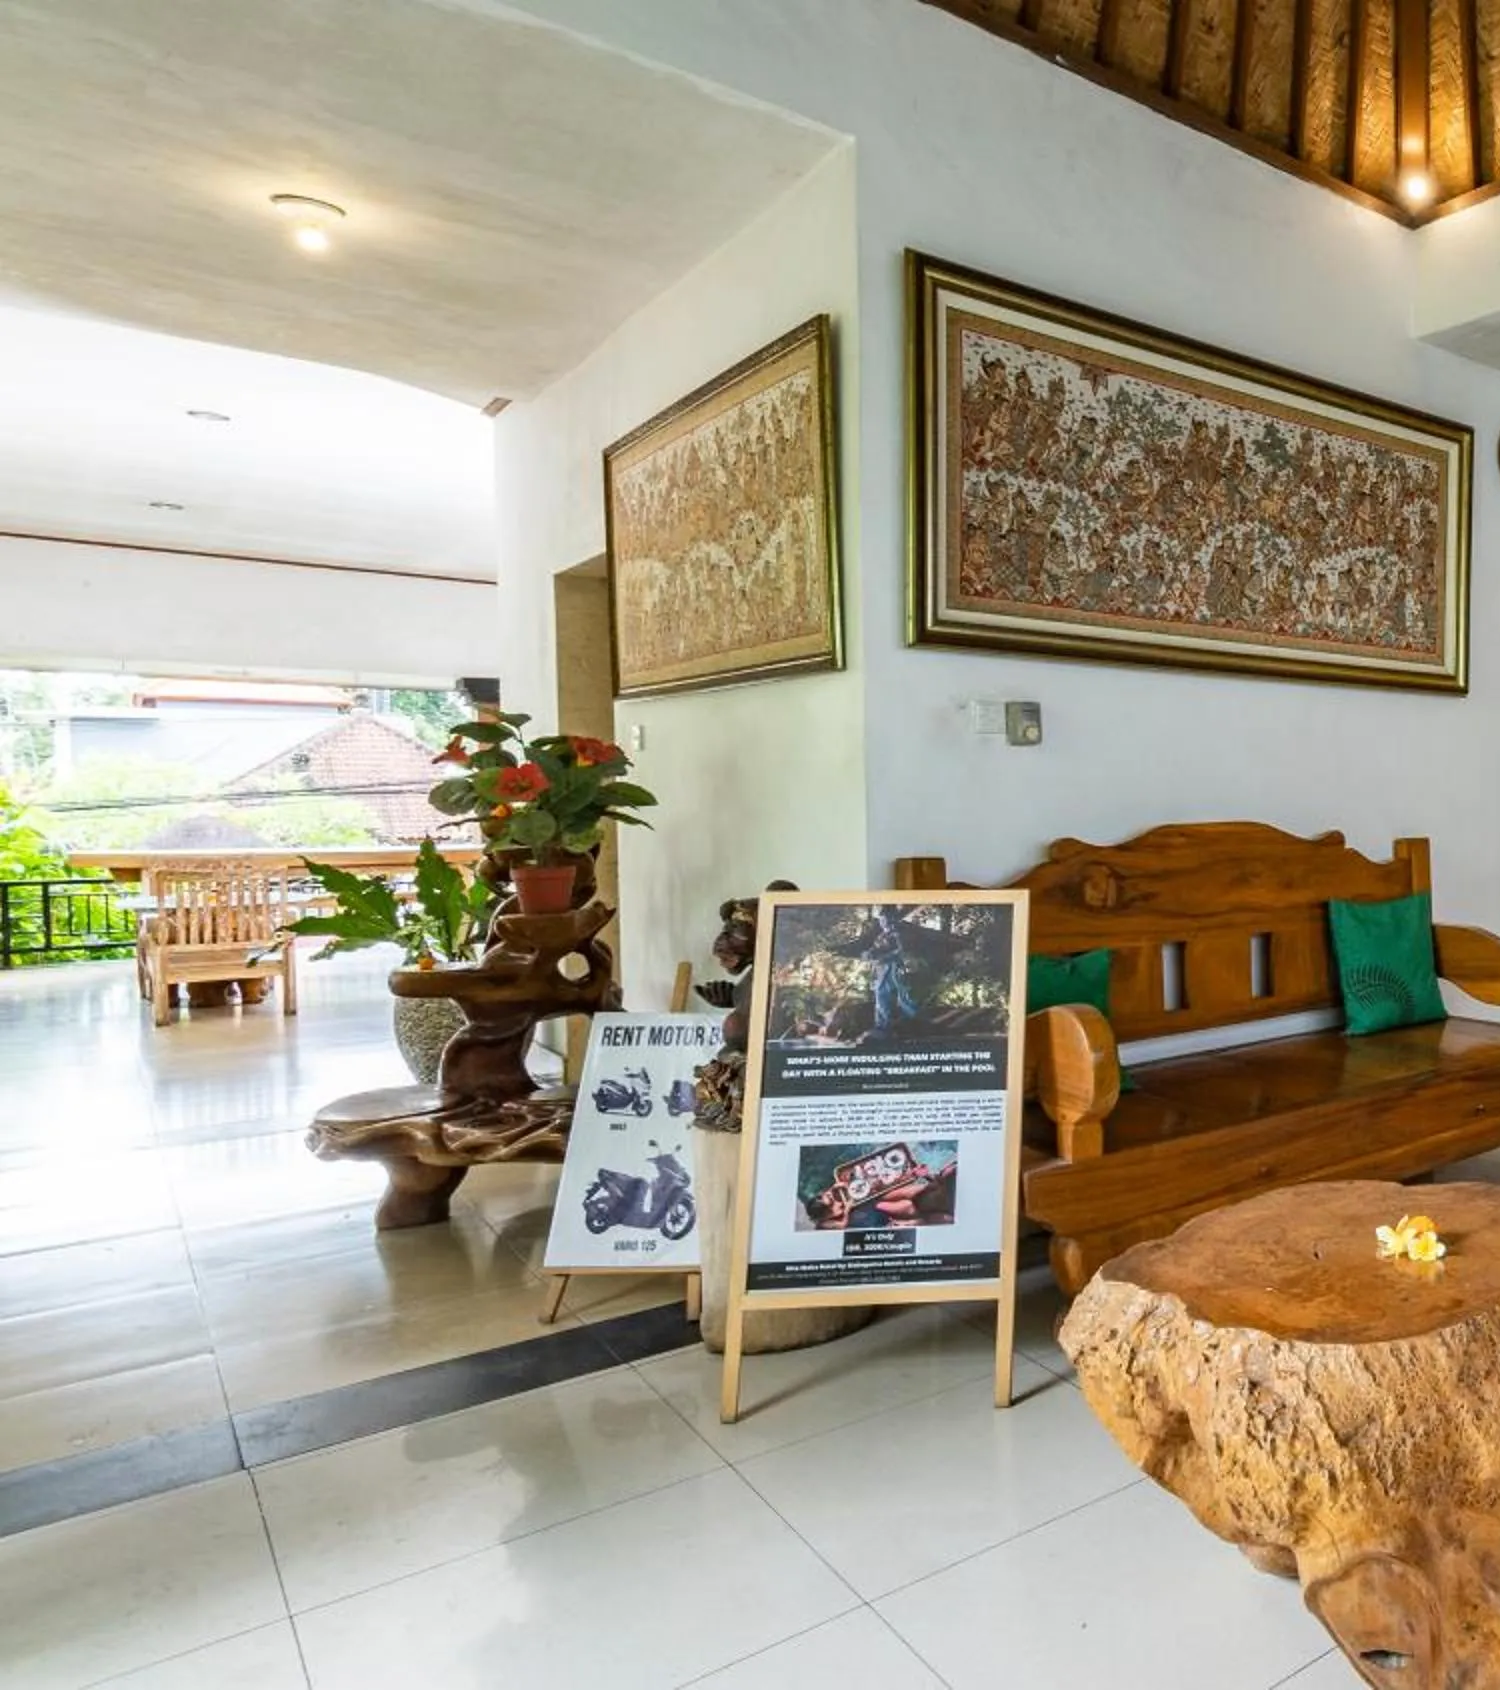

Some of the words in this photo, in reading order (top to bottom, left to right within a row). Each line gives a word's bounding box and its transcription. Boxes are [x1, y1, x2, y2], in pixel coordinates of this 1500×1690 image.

[601, 1025, 646, 1047] RENT
[649, 1026, 706, 1047] MOTOR
[903, 1053, 928, 1062] THAN
[930, 1052, 974, 1061] STARTING
[975, 1051, 992, 1060] THE
[782, 1070, 801, 1079] DAY
[803, 1069, 827, 1078] WITH
[827, 1068, 837, 1077] A
[838, 1067, 881, 1076] FLOATING
[942, 1065, 953, 1074] IN
[954, 1064, 971, 1073] THE
[972, 1064, 995, 1073] POOL
